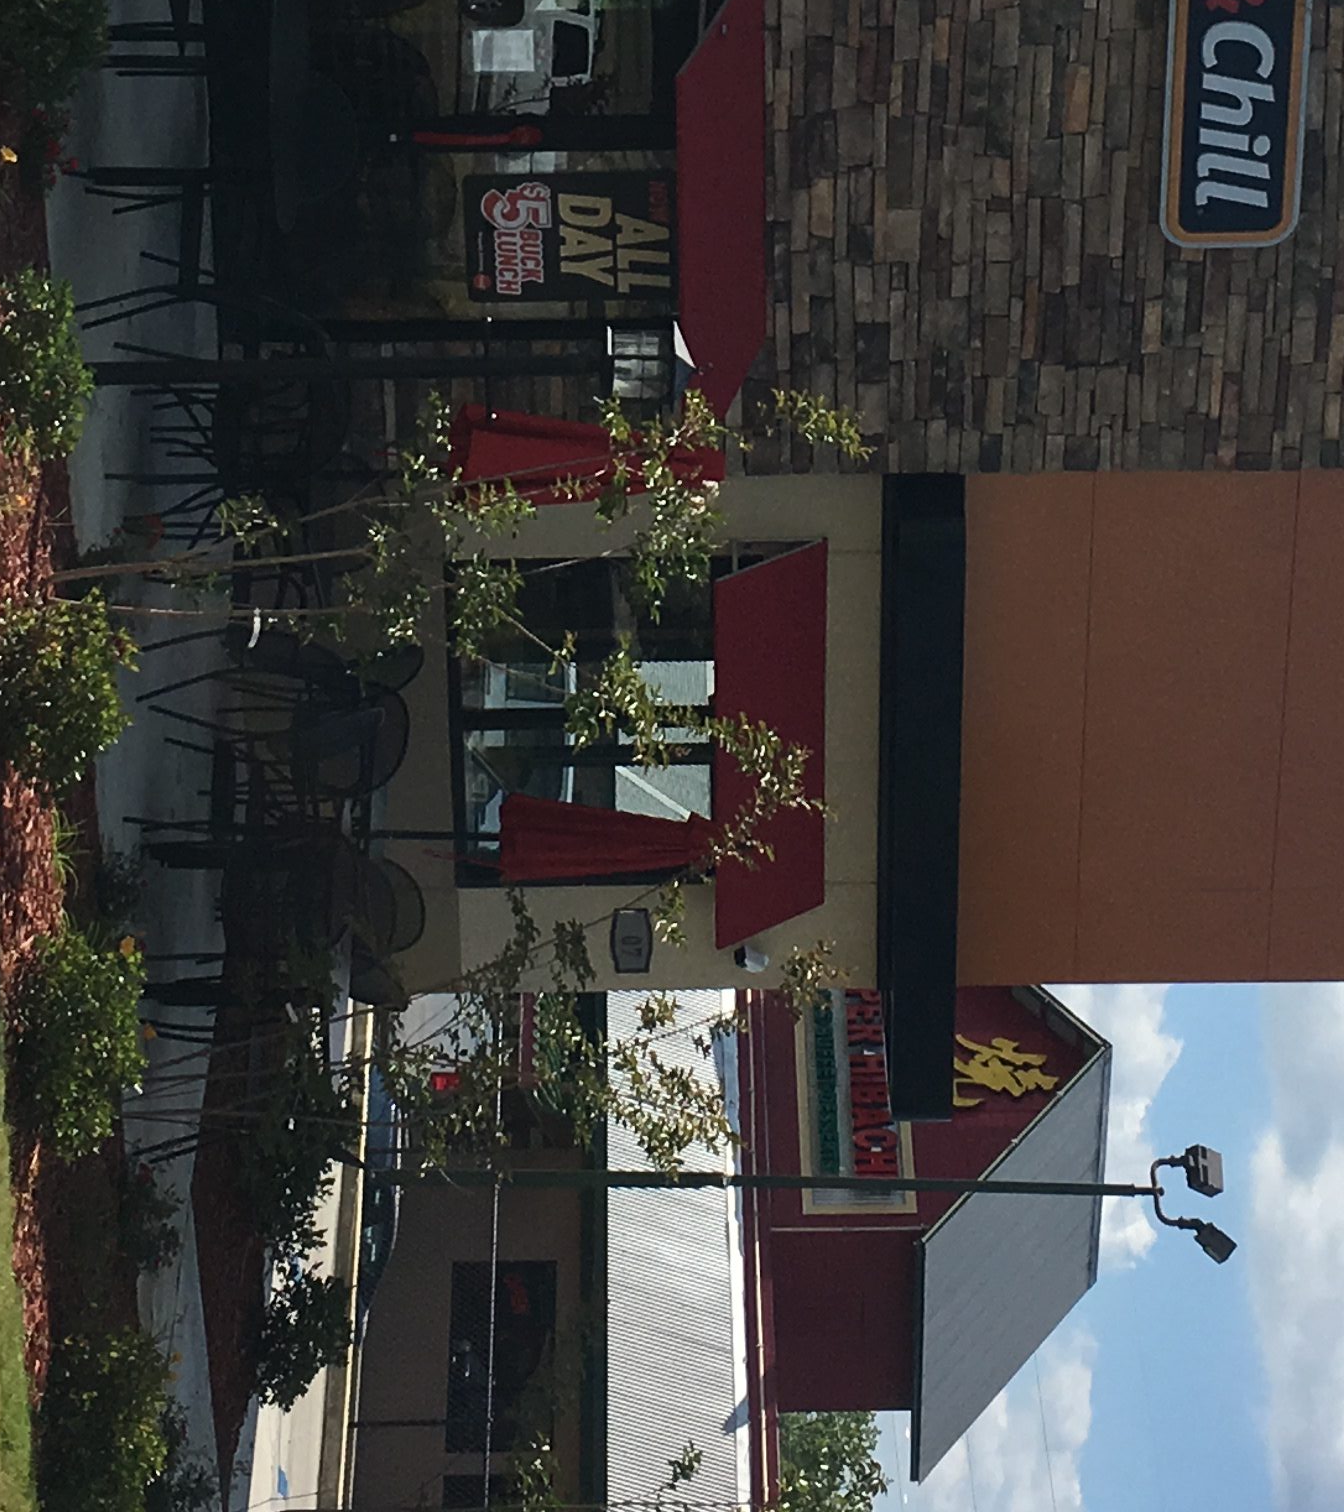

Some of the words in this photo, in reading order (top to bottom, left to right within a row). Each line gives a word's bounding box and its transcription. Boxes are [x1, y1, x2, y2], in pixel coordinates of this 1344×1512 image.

[1194, 19, 1277, 209] Chill
[480, 183, 551, 230] $5
[520, 230, 543, 283] BUCK
[495, 231, 521, 295] LUNCH
[557, 193, 614, 286] DAY
[615, 213, 671, 293] ALL
[848, 1054, 899, 1178] HIBACH
